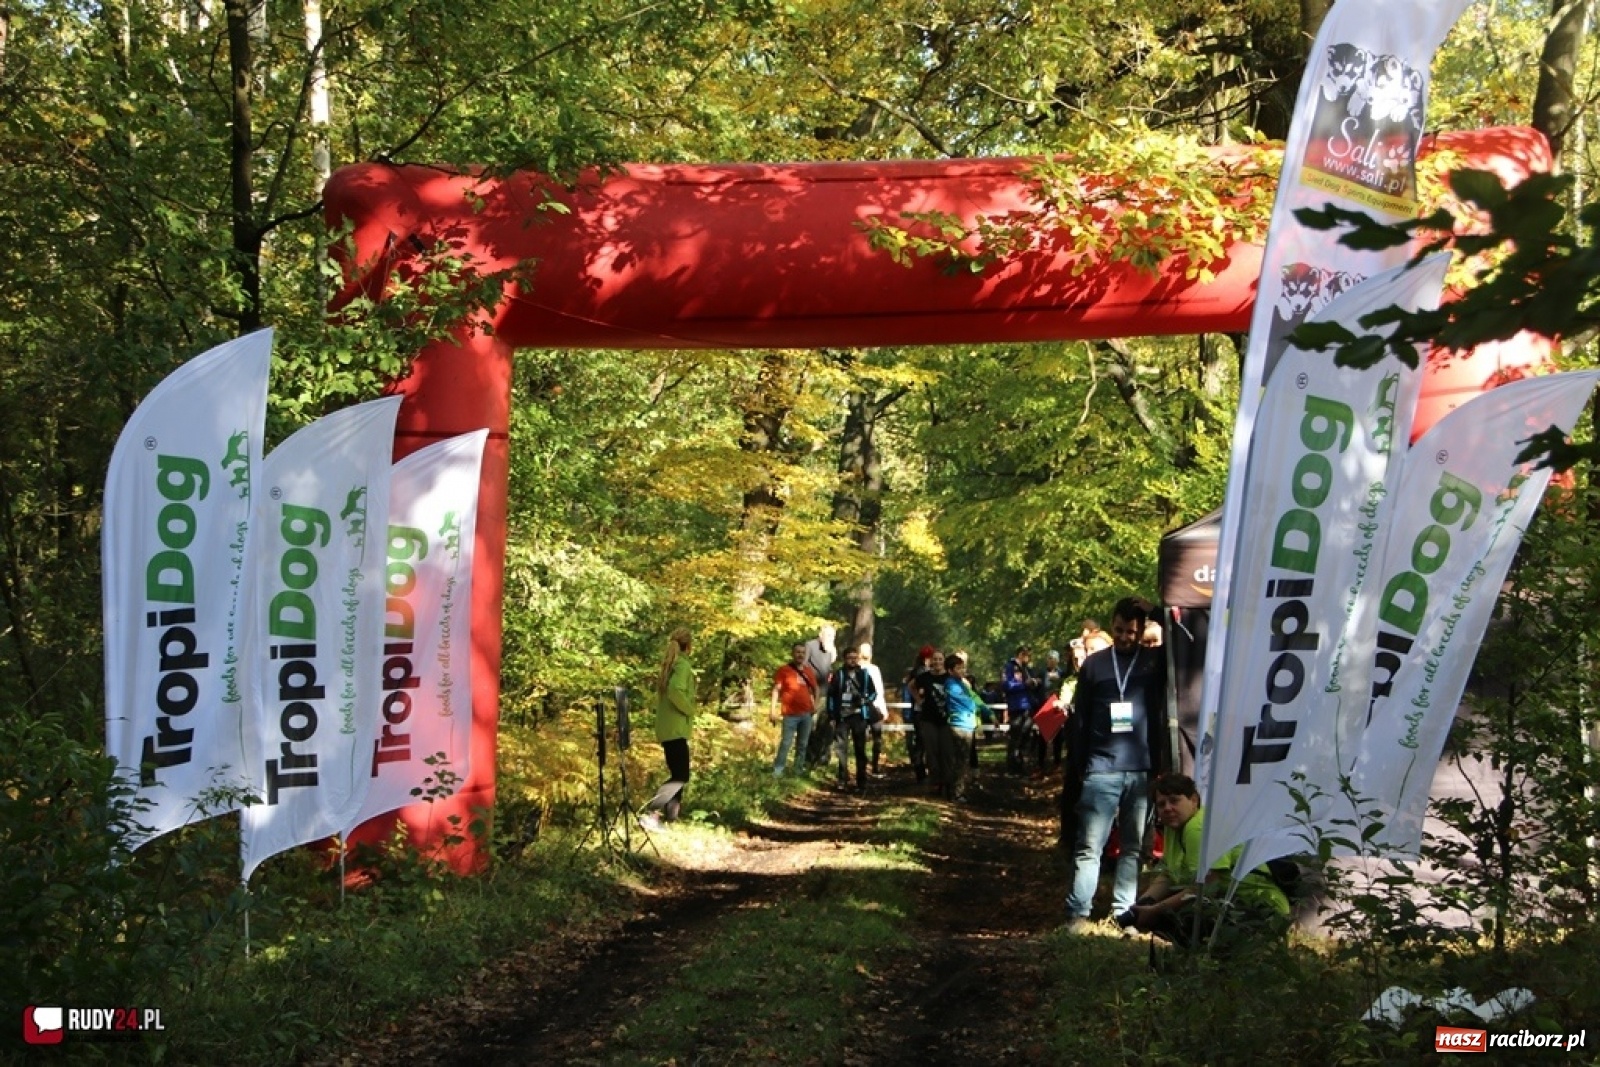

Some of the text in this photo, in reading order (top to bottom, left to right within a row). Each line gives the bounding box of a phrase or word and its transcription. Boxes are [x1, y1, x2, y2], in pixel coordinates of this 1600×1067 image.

[1327, 117, 1382, 169] Sali
[1322, 157, 1407, 193] www.sali.pl
[1366, 193, 1413, 213] Equipment
[1358, 481, 1387, 520] dogs
[229, 521, 248, 553] dogs
[1358, 522, 1378, 540] of
[441, 576, 456, 600] dogs
[1236, 394, 1354, 785] TropiDog
[1453, 593, 1471, 610] of
[141, 454, 210, 787] TropiDog
[437, 615, 450, 650] breeds
[1431, 612, 1461, 657] breeds
[267, 502, 332, 806] TropiDog
[339, 568, 364, 734] foods for all breeds of dogs
[371, 524, 430, 778] TropiDog
[437, 652, 450, 669] all
[221, 665, 242, 703] foods
[437, 672, 453, 687] for
[1424, 657, 1439, 683] all
[436, 688, 453, 717] foods
[1411, 684, 1430, 708] for
[1398, 711, 1424, 749] foods
